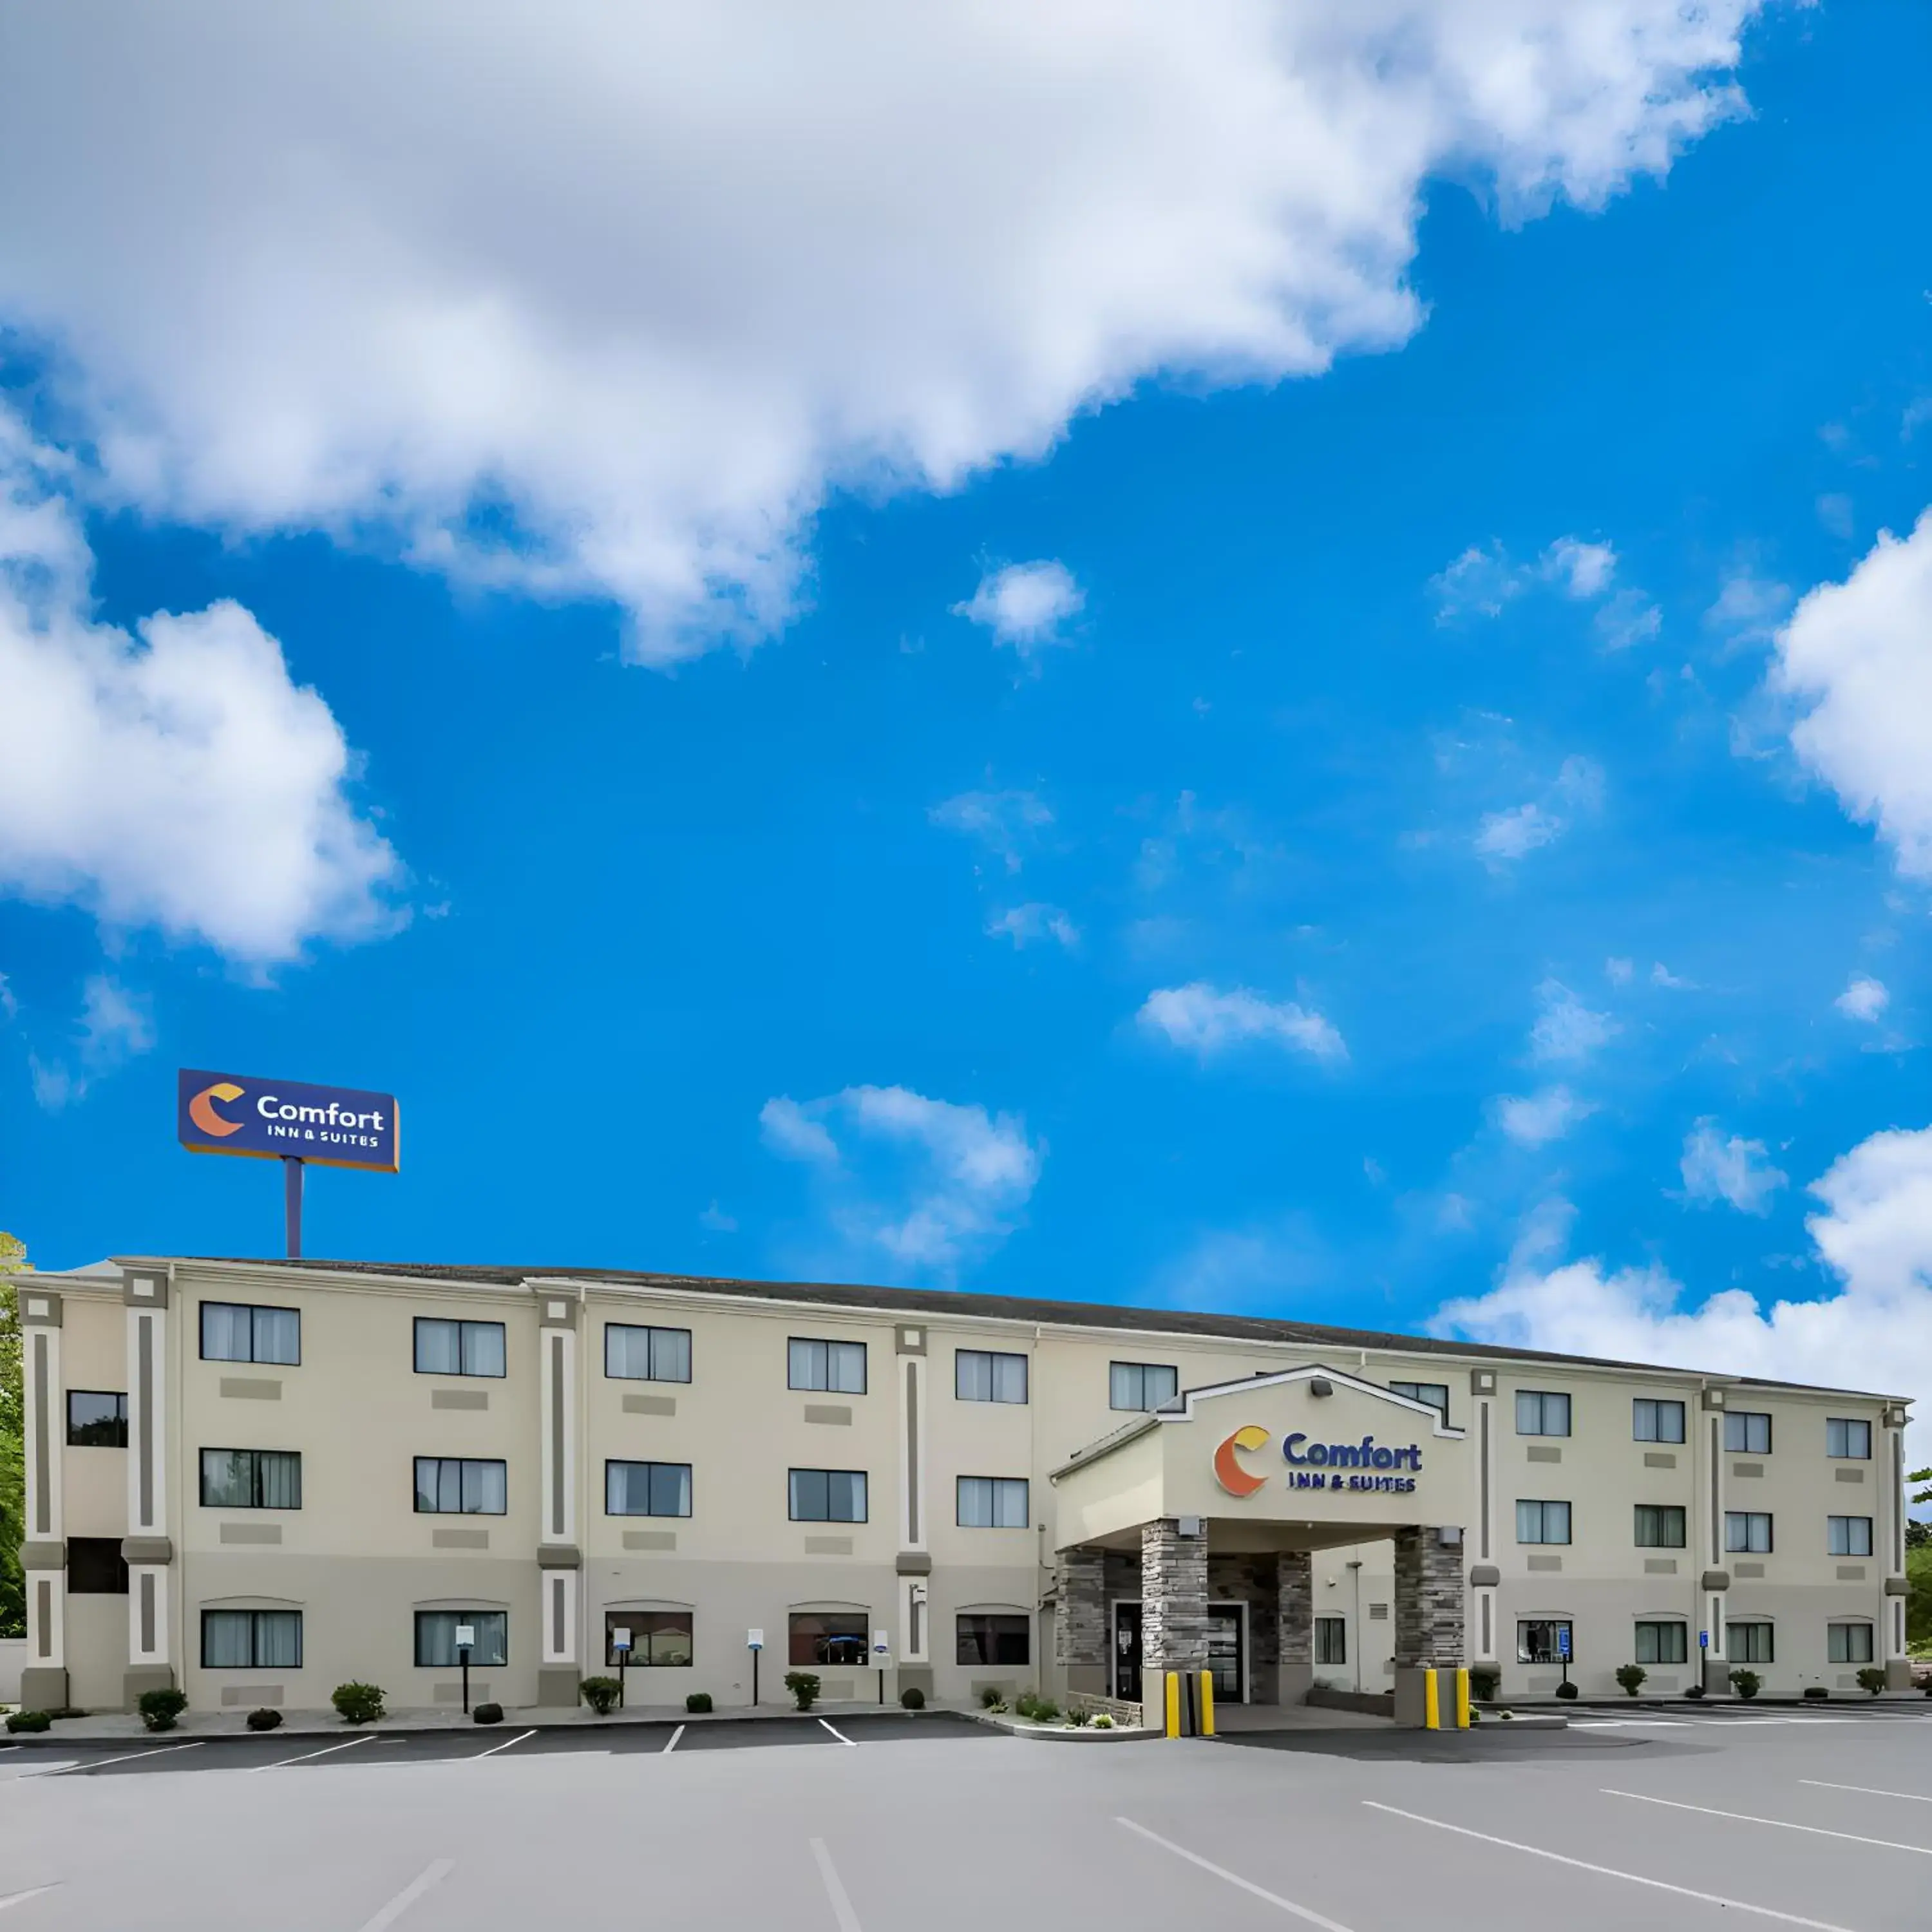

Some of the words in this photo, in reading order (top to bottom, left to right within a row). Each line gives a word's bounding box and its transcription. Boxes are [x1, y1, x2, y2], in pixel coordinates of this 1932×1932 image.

[258, 1095, 384, 1130] Comfort
[267, 1125, 299, 1139] INN
[320, 1132, 379, 1147] SUITES
[1283, 1432, 1422, 1471] Comfort
[1289, 1472, 1325, 1489] INN
[1331, 1474, 1344, 1490] &
[1349, 1476, 1416, 1493] SUITES
